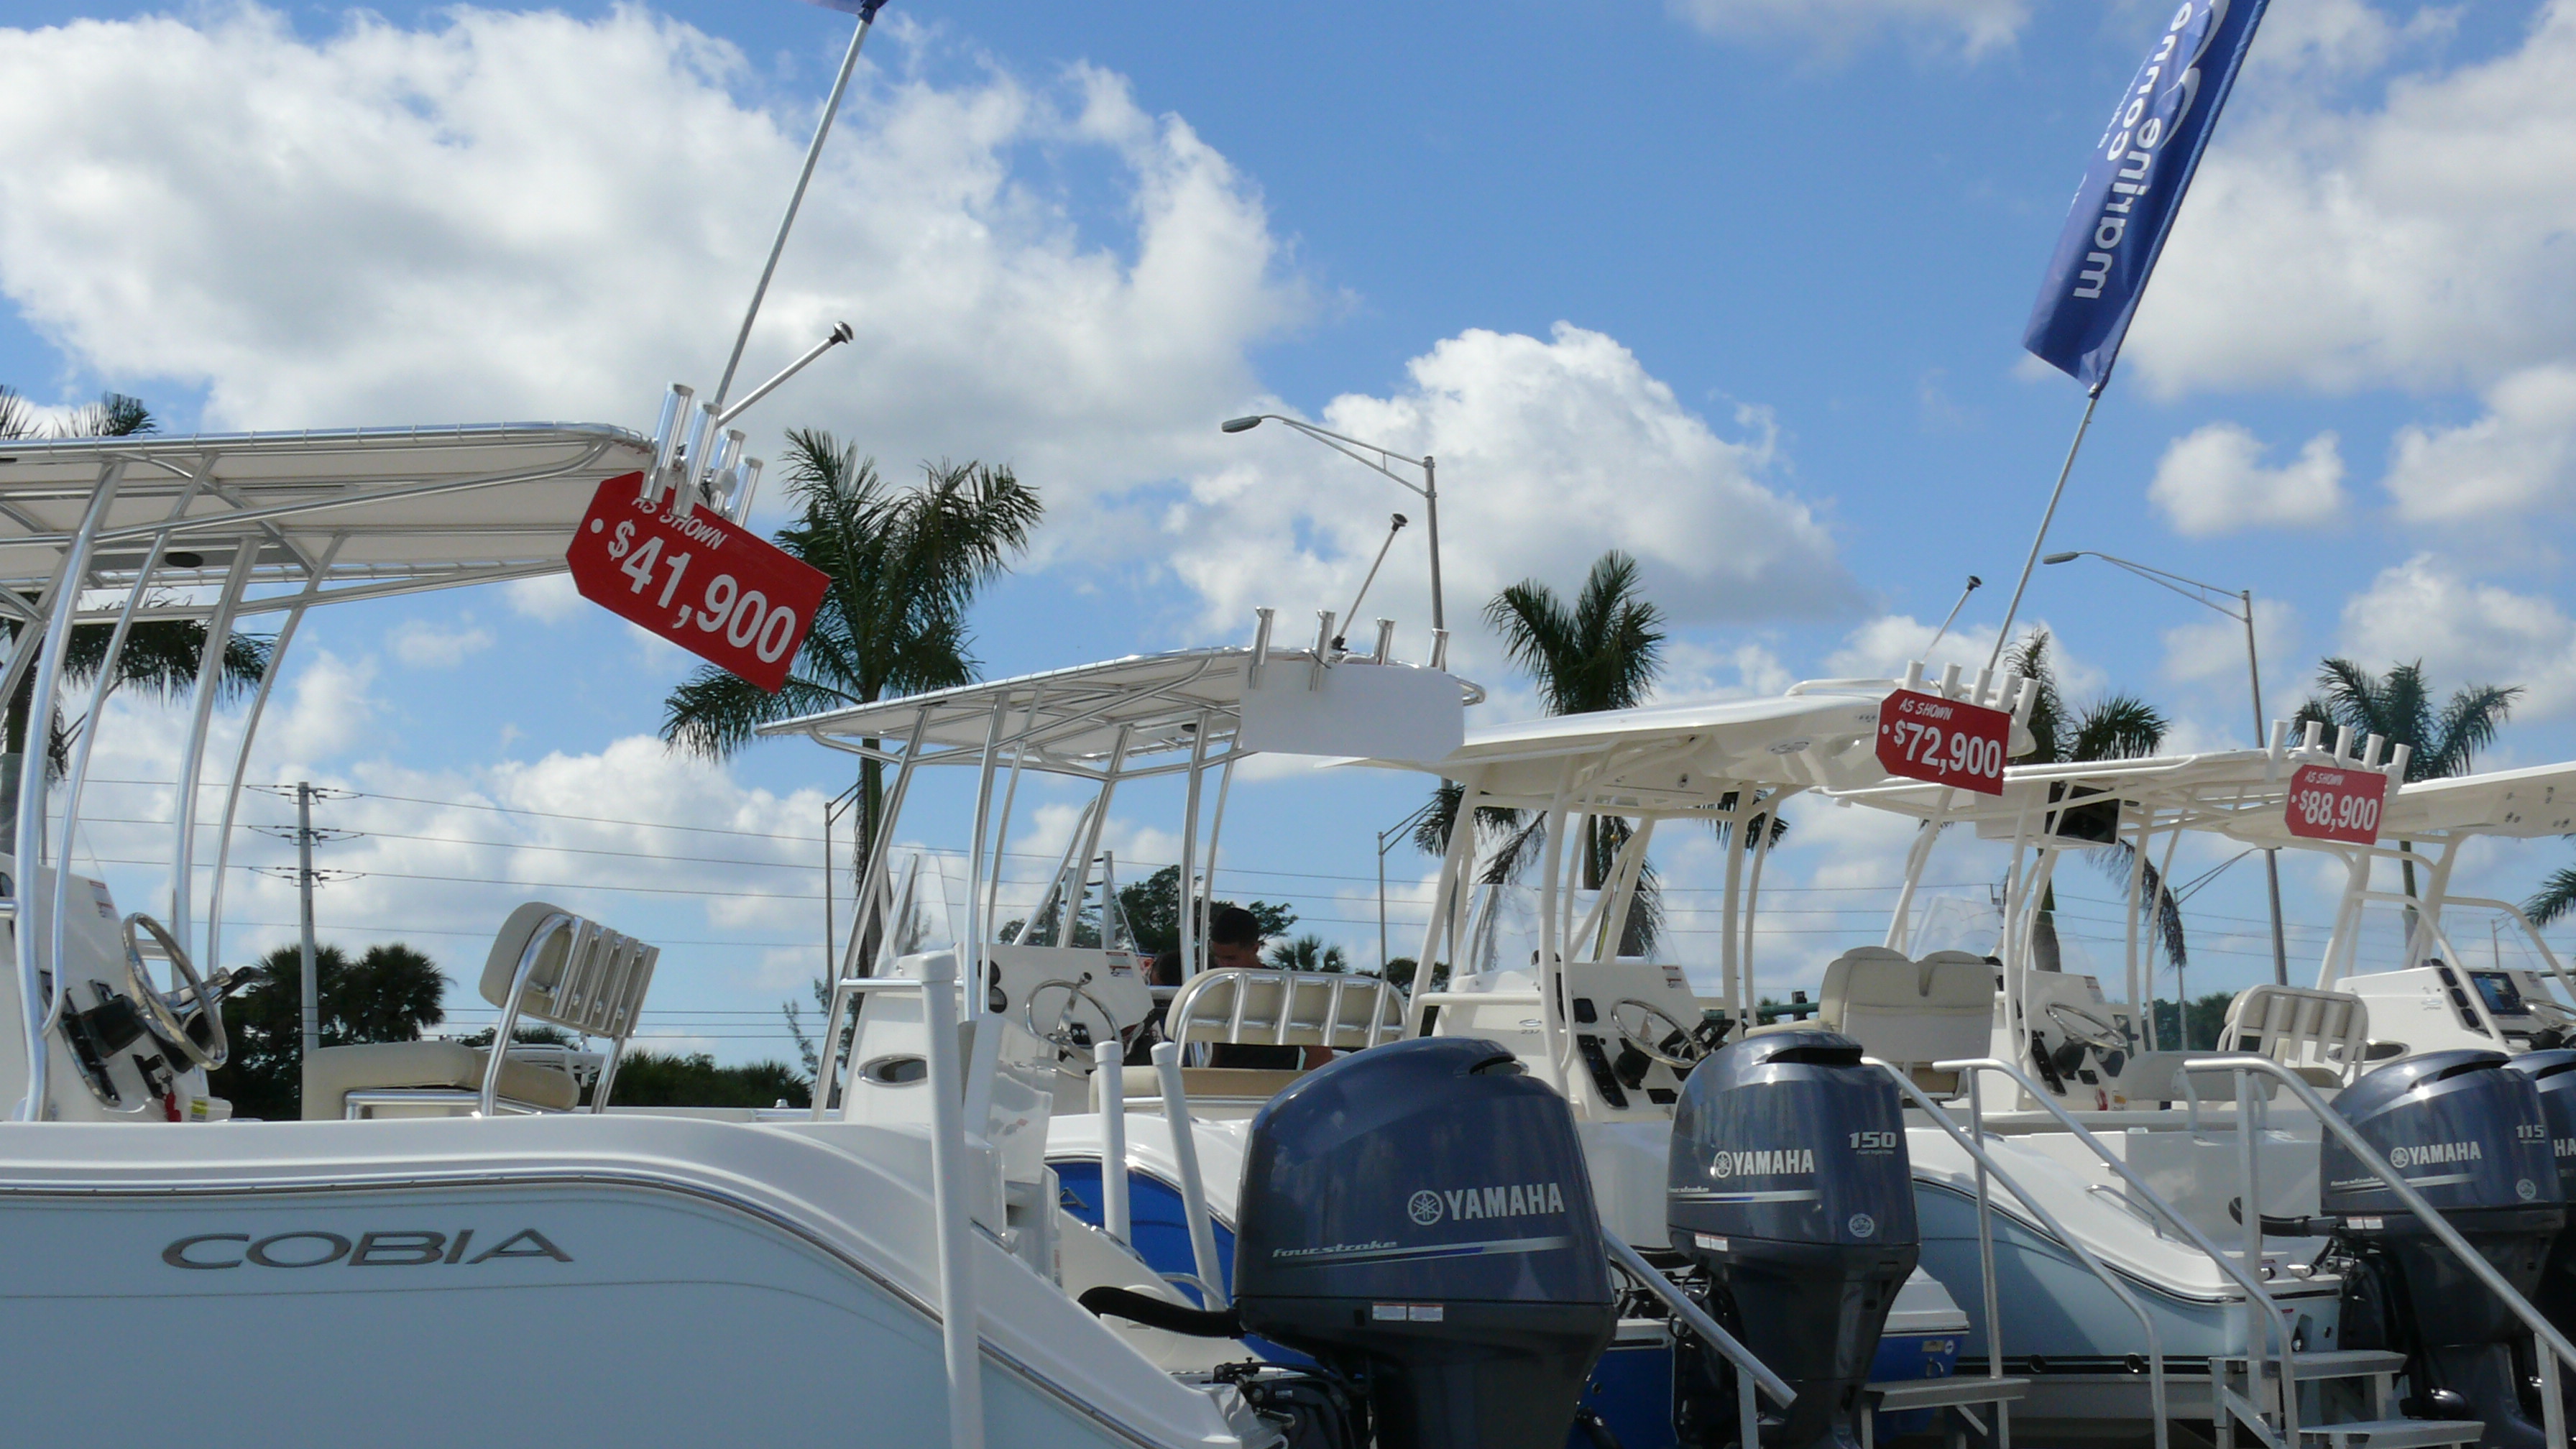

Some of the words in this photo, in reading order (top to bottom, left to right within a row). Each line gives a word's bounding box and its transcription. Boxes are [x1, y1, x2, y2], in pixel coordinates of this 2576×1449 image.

[658, 507, 728, 551] SHOWN
[607, 519, 796, 664] $41,900
[1898, 698, 1915, 714] AS
[1915, 702, 1954, 721] SHOWN
[1893, 719, 2002, 779] $72,900
[2304, 770, 2317, 783] AS
[2299, 789, 2378, 833] $88,900
[1849, 1131, 1897, 1149] 150
[2516, 1124, 2545, 1138] 115
[1732, 1149, 1816, 1176] YAMAHA
[2409, 1141, 2483, 1166] YAMAHA
[1445, 1182, 1565, 1221] YAMAHA
[161, 1228, 575, 1270] COBIA
[1271, 1240, 1398, 1259] fourstroke
